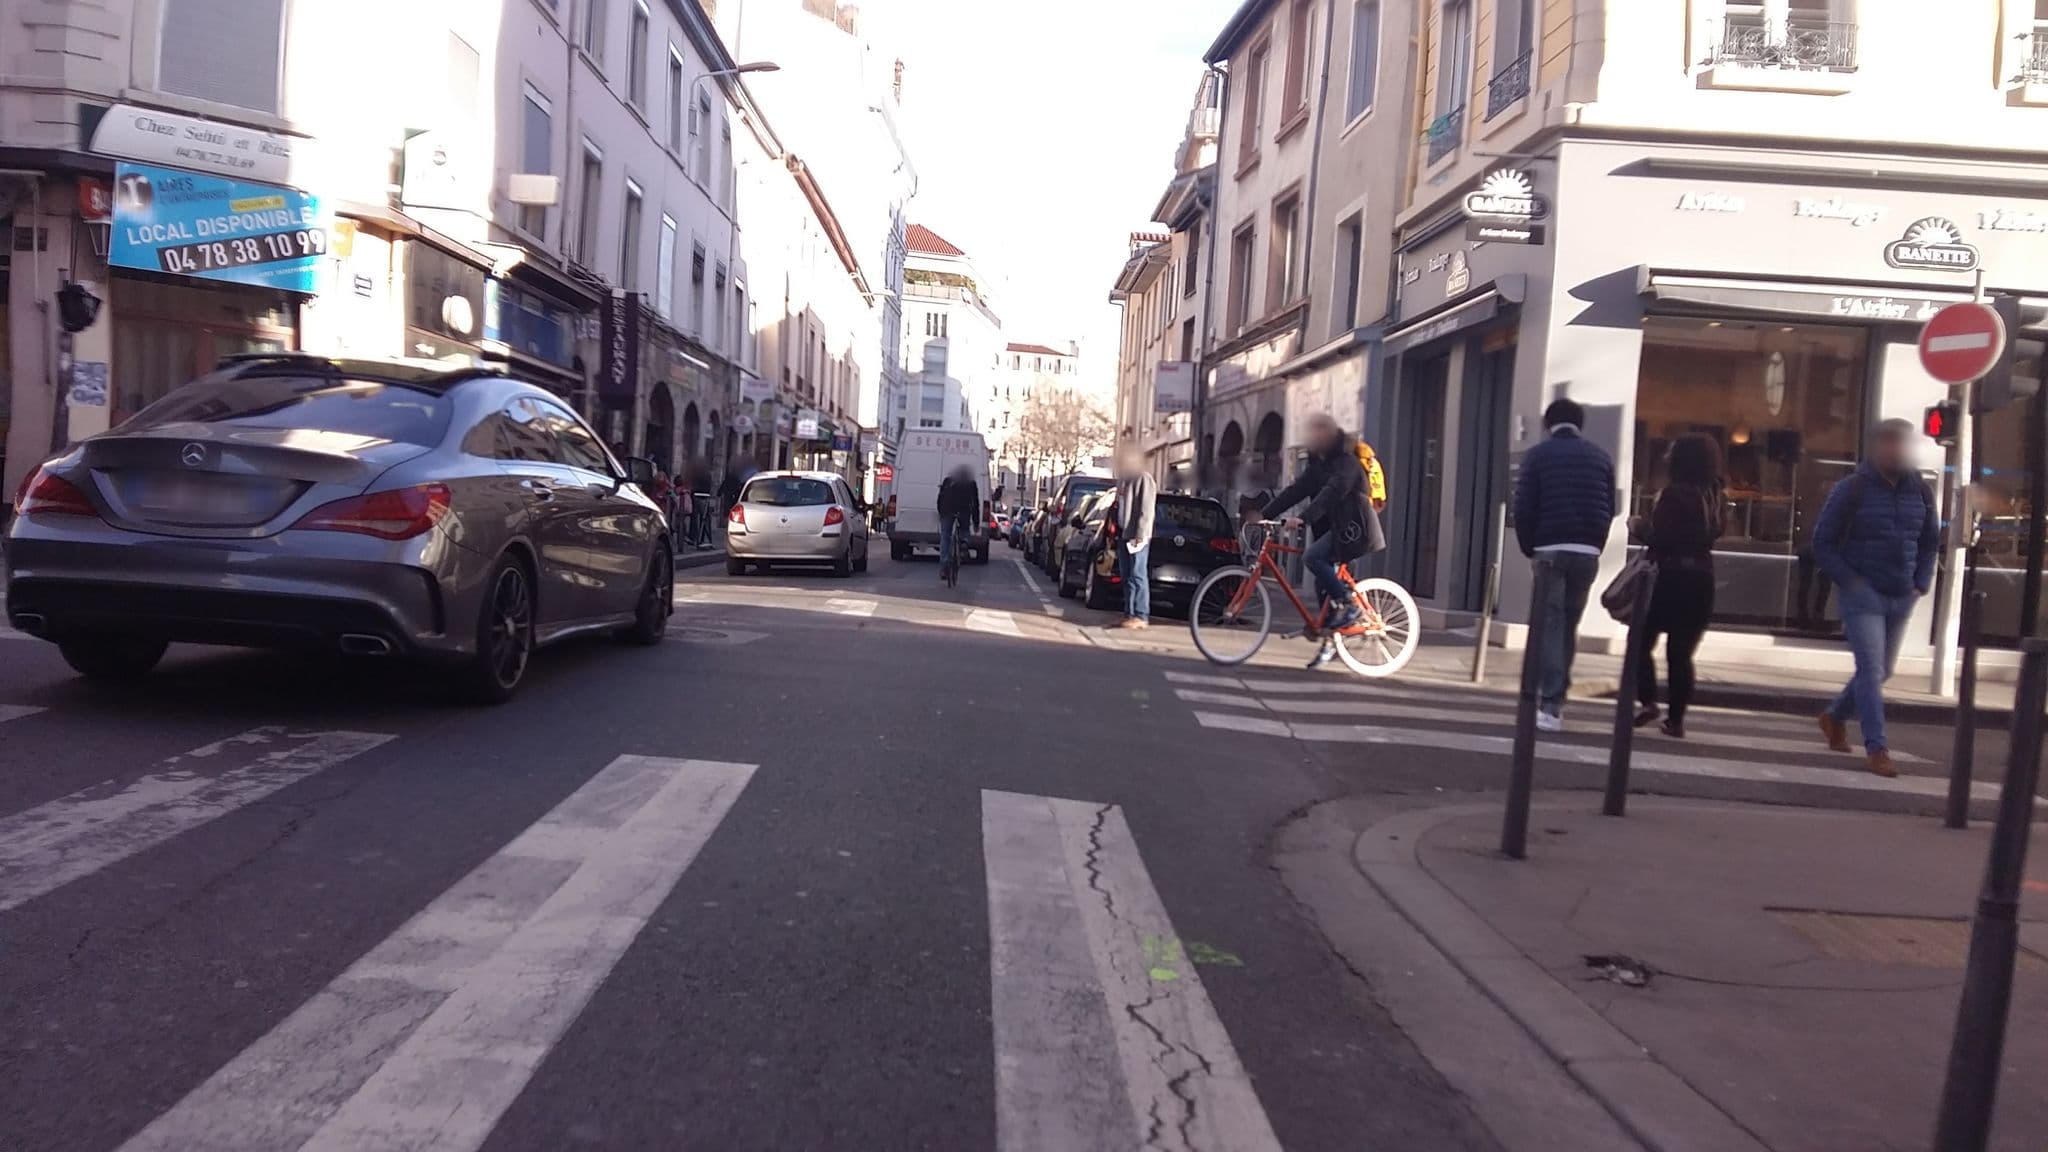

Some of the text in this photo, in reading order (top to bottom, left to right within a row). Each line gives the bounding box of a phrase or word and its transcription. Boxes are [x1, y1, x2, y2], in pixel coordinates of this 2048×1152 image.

[134, 116, 176, 137] Chez
[126, 206, 313, 246] LOCAL DISPONIBLE
[165, 228, 326, 273] 04 78 38 10 99
[1899, 245, 1972, 265] BANETTE
[1832, 296, 1910, 319] L'Atelier
